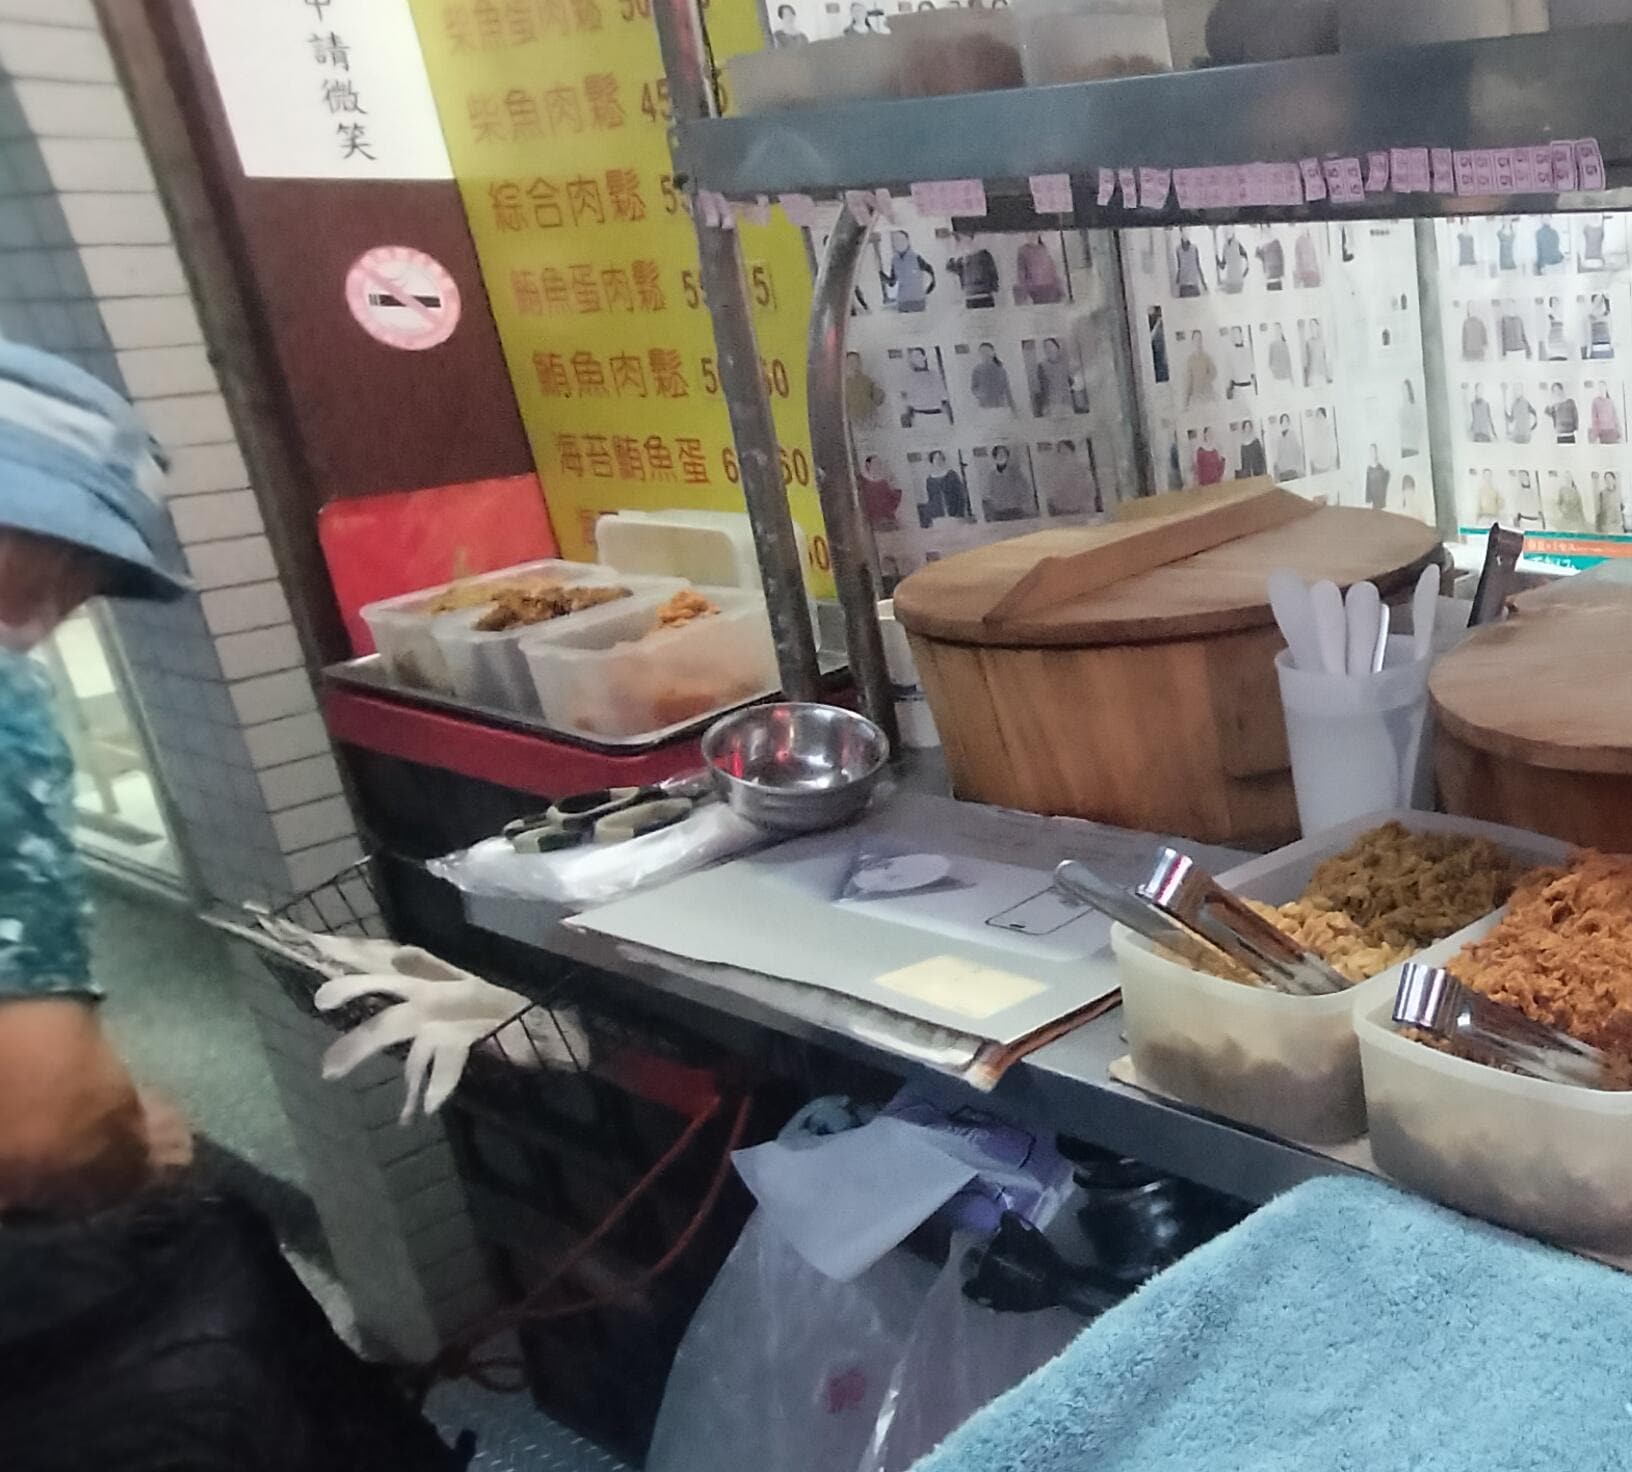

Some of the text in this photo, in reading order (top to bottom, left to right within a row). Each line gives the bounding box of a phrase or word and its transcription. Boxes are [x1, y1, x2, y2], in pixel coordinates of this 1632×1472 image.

[467, 72, 628, 144] 柴魚肉鬆
[489, 167, 647, 231] 綜合肉鬆
[533, 347, 691, 399] 鮪魚肉鬆
[555, 432, 712, 485] 海苔鮪魚蛋
[808, 535, 831, 571] 0
